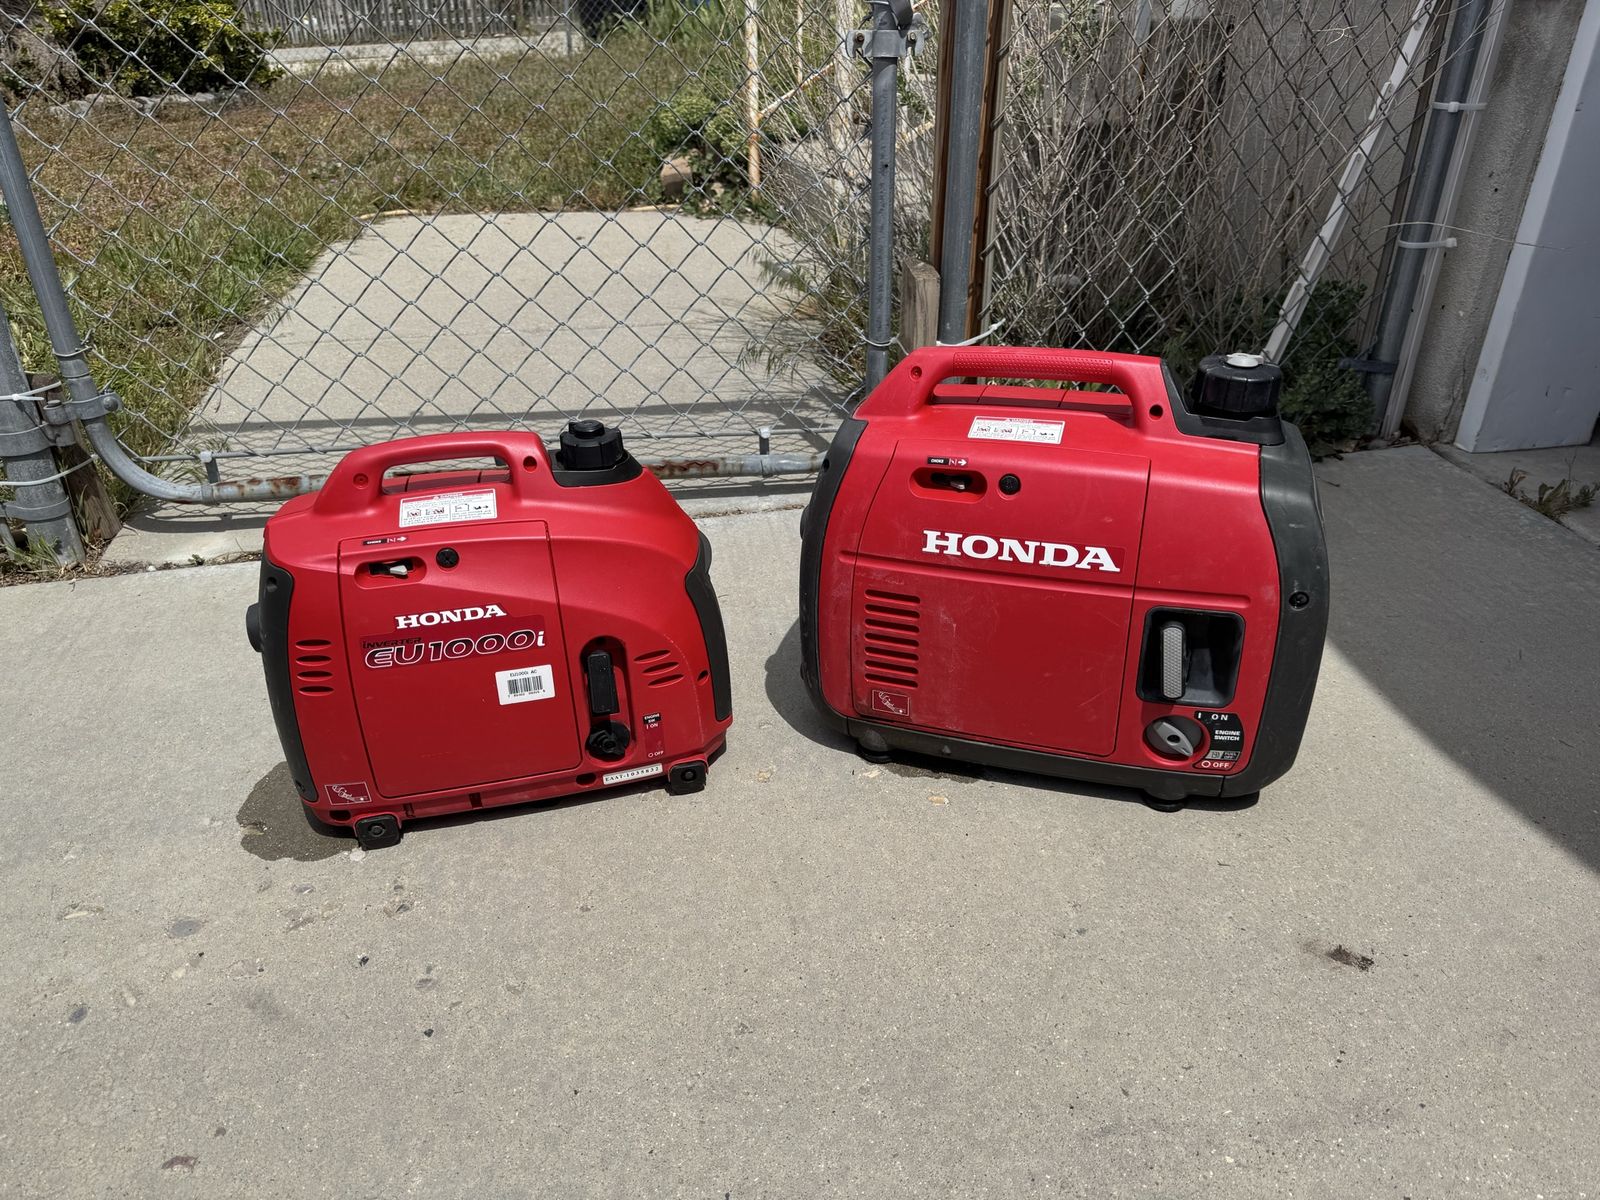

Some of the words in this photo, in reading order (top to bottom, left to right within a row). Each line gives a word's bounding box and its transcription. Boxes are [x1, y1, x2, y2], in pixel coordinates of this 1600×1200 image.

[922, 530, 1121, 573] HONDA
[394, 604, 507, 630] HONDA
[364, 629, 546, 669] EU1000i
[1211, 713, 1229, 721] ON
